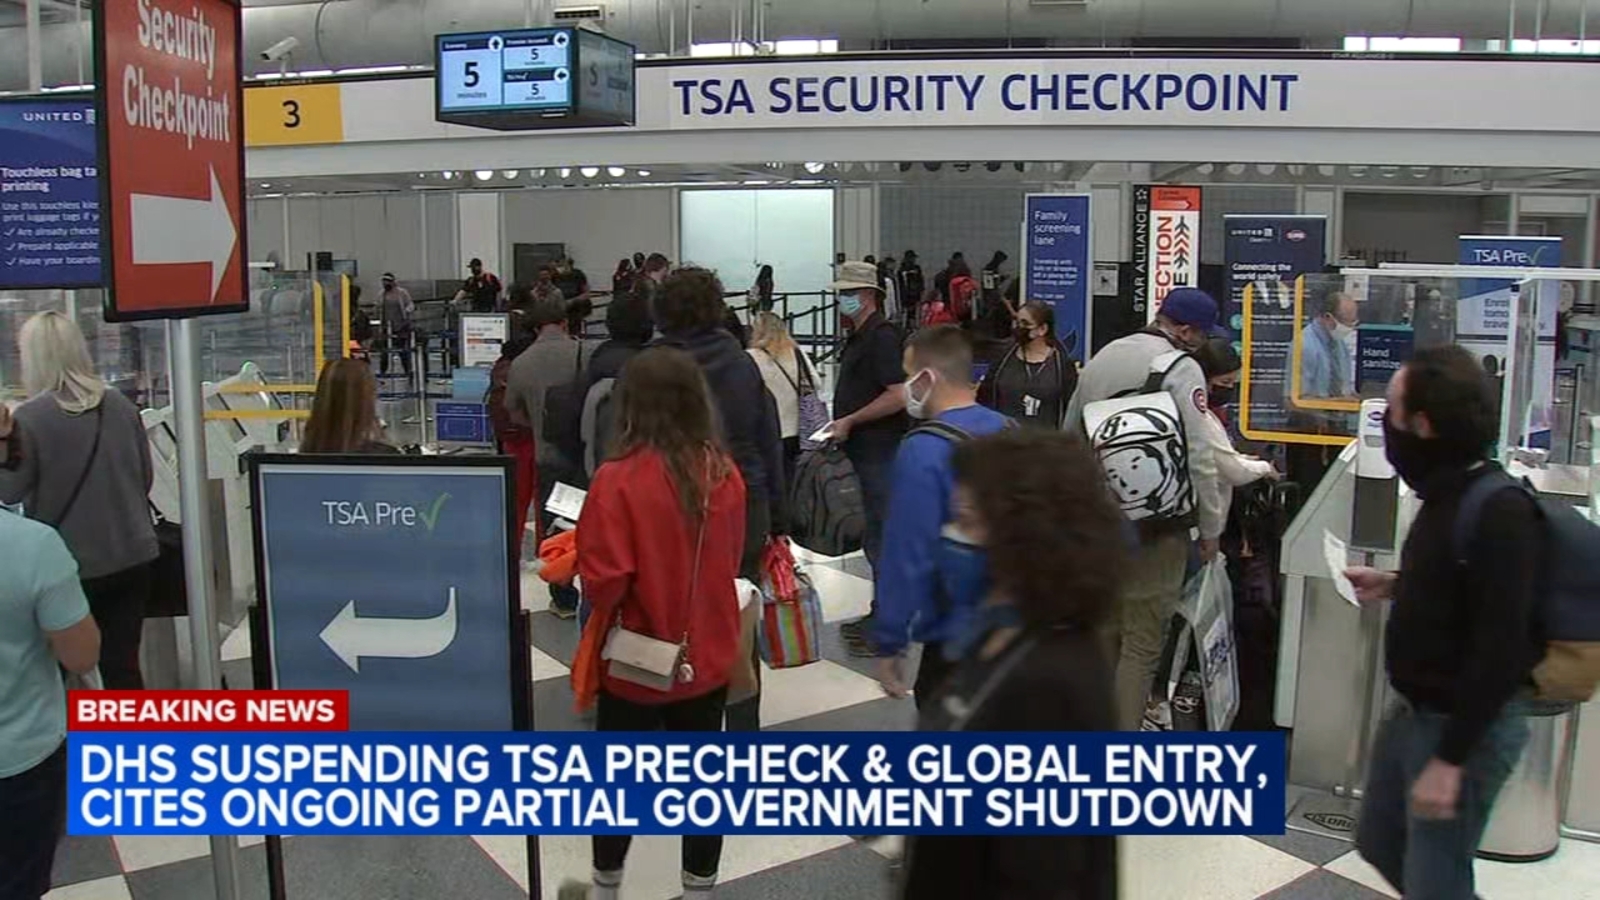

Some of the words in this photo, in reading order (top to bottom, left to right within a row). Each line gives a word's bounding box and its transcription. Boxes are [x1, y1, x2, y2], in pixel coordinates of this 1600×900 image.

[137, 0, 215, 80] Security
[531, 48, 539, 60] 5
[464, 61, 479, 88] 5
[531, 83, 540, 95] 5
[673, 78, 755, 115] TSA
[769, 74, 985, 113] SECURITY
[1001, 73, 1298, 111] CHECKPOINT
[123, 63, 231, 150] Checkpoint
[23, 112, 82, 121] UNITED
[282, 100, 300, 128] 3
[0, 167, 58, 178] Touchless
[60, 167, 83, 179] bag
[84, 167, 97, 177] ta
[1, 181, 50, 193] printing
[1034, 210, 1068, 222] Family
[69, 228, 99, 236] checke
[1034, 223, 1081, 235] screening
[1034, 234, 1055, 246] lane
[1135, 204, 1148, 273] ALLIANCE
[19, 257, 41, 266] Have
[65, 256, 100, 267] boardin
[1155, 216, 1173, 306] ECTION
[1474, 249, 1500, 263] TSA
[1503, 249, 1527, 263] Pre
[1231, 263, 1276, 272] Connecting
[1277, 263, 1292, 271] the
[1232, 272, 1256, 281] world
[1257, 272, 1281, 281] safely
[1133, 277, 1146, 312] STAR
[1362, 347, 1390, 357] Hand
[1362, 359, 1401, 370] sanitize
[322, 501, 369, 525] TSA
[375, 502, 416, 526] Pre
